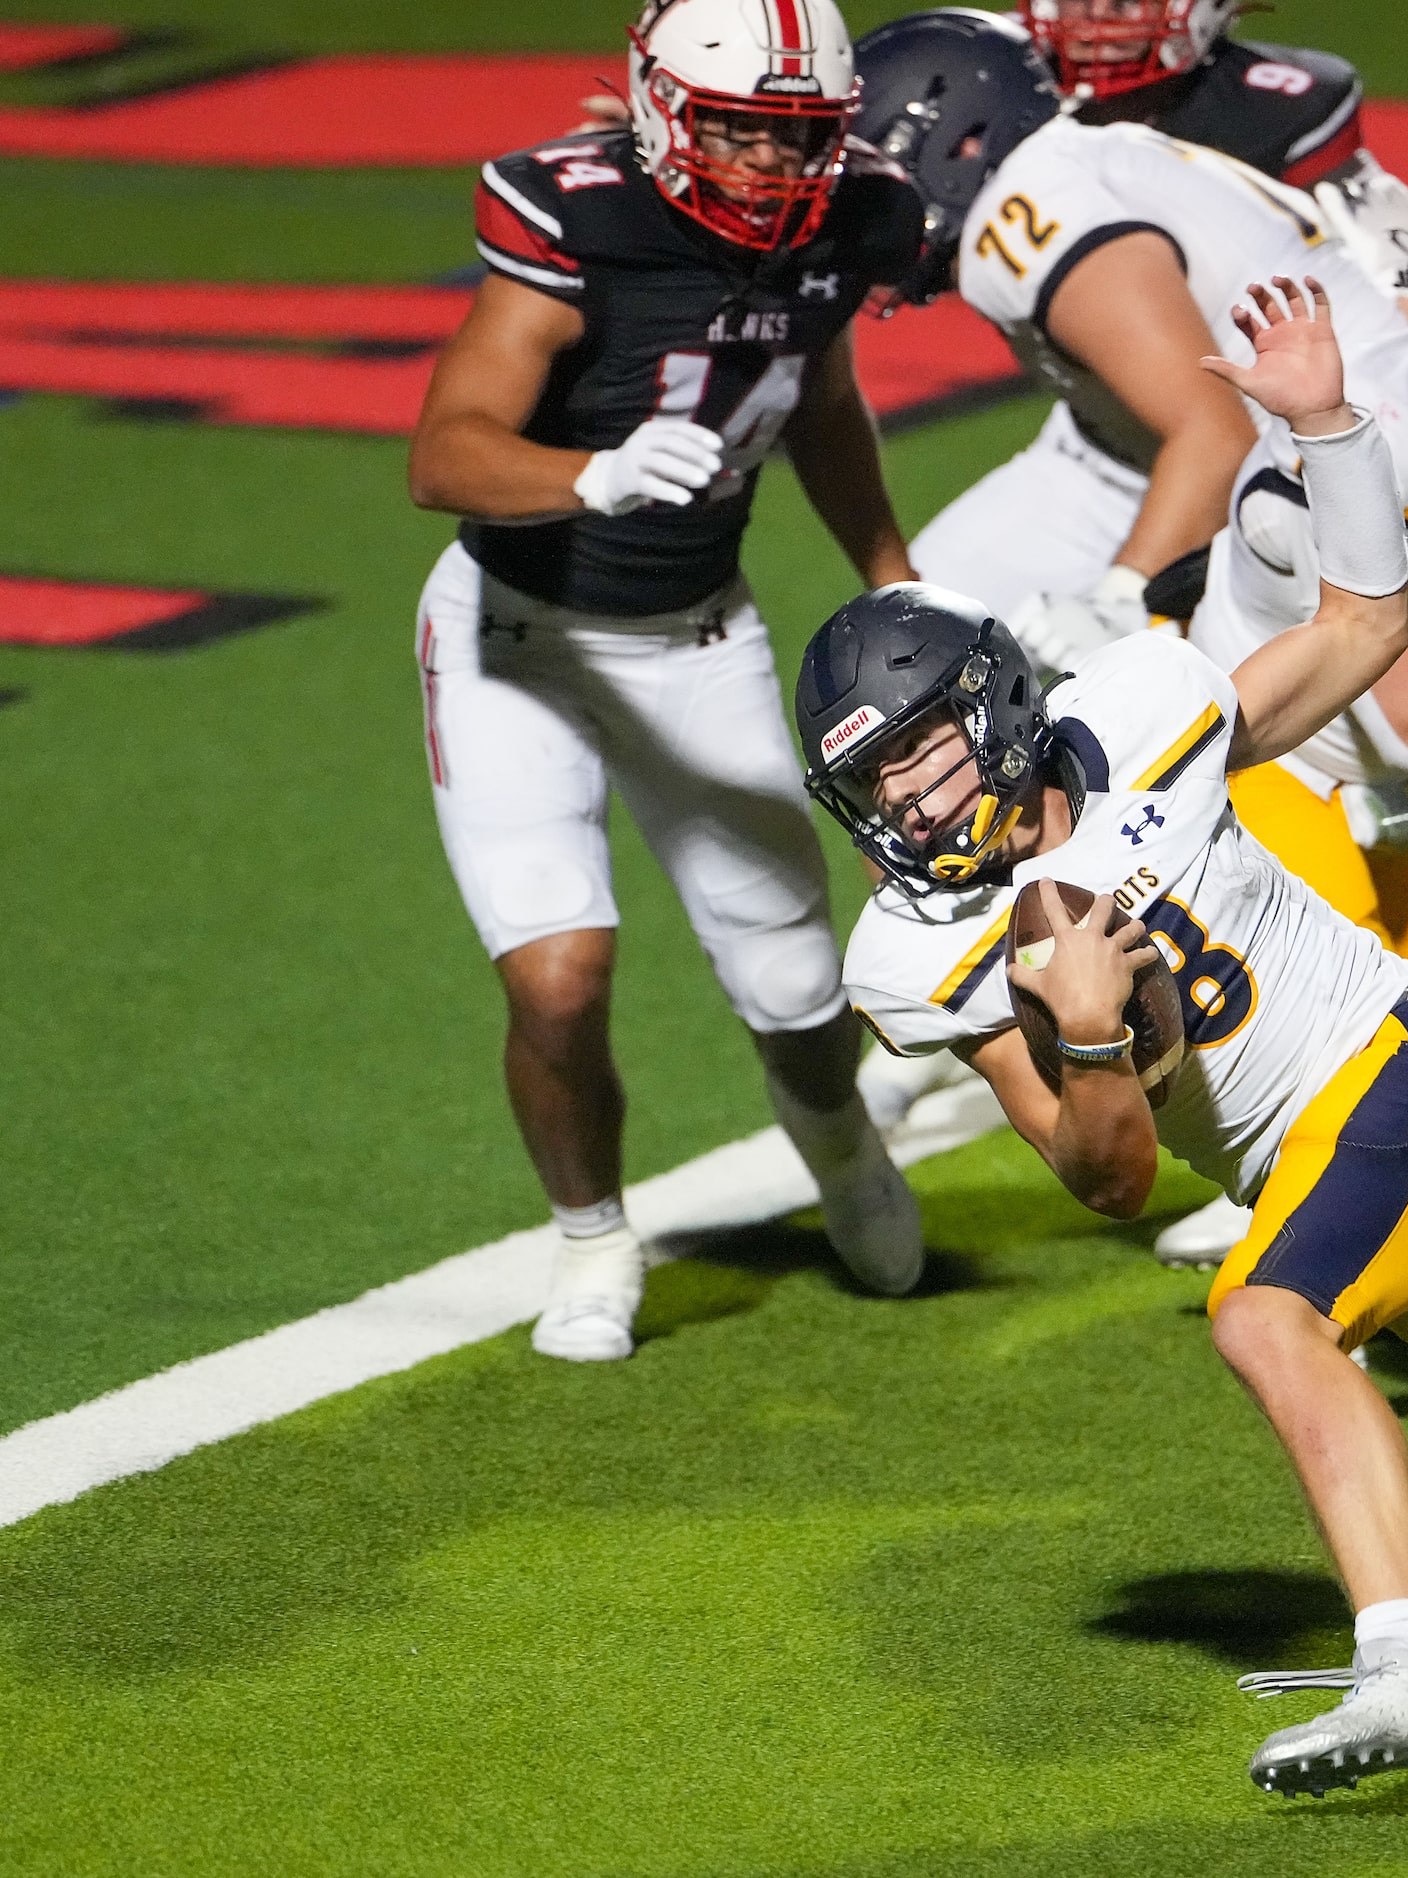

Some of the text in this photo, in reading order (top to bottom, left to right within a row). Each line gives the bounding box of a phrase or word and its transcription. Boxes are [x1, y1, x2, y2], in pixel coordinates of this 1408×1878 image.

[530, 143, 626, 193] 14
[975, 191, 1062, 281] 72
[823, 710, 870, 753] Riddell
[1112, 866, 1161, 911] OTS
[1139, 893, 1260, 1050] 8
